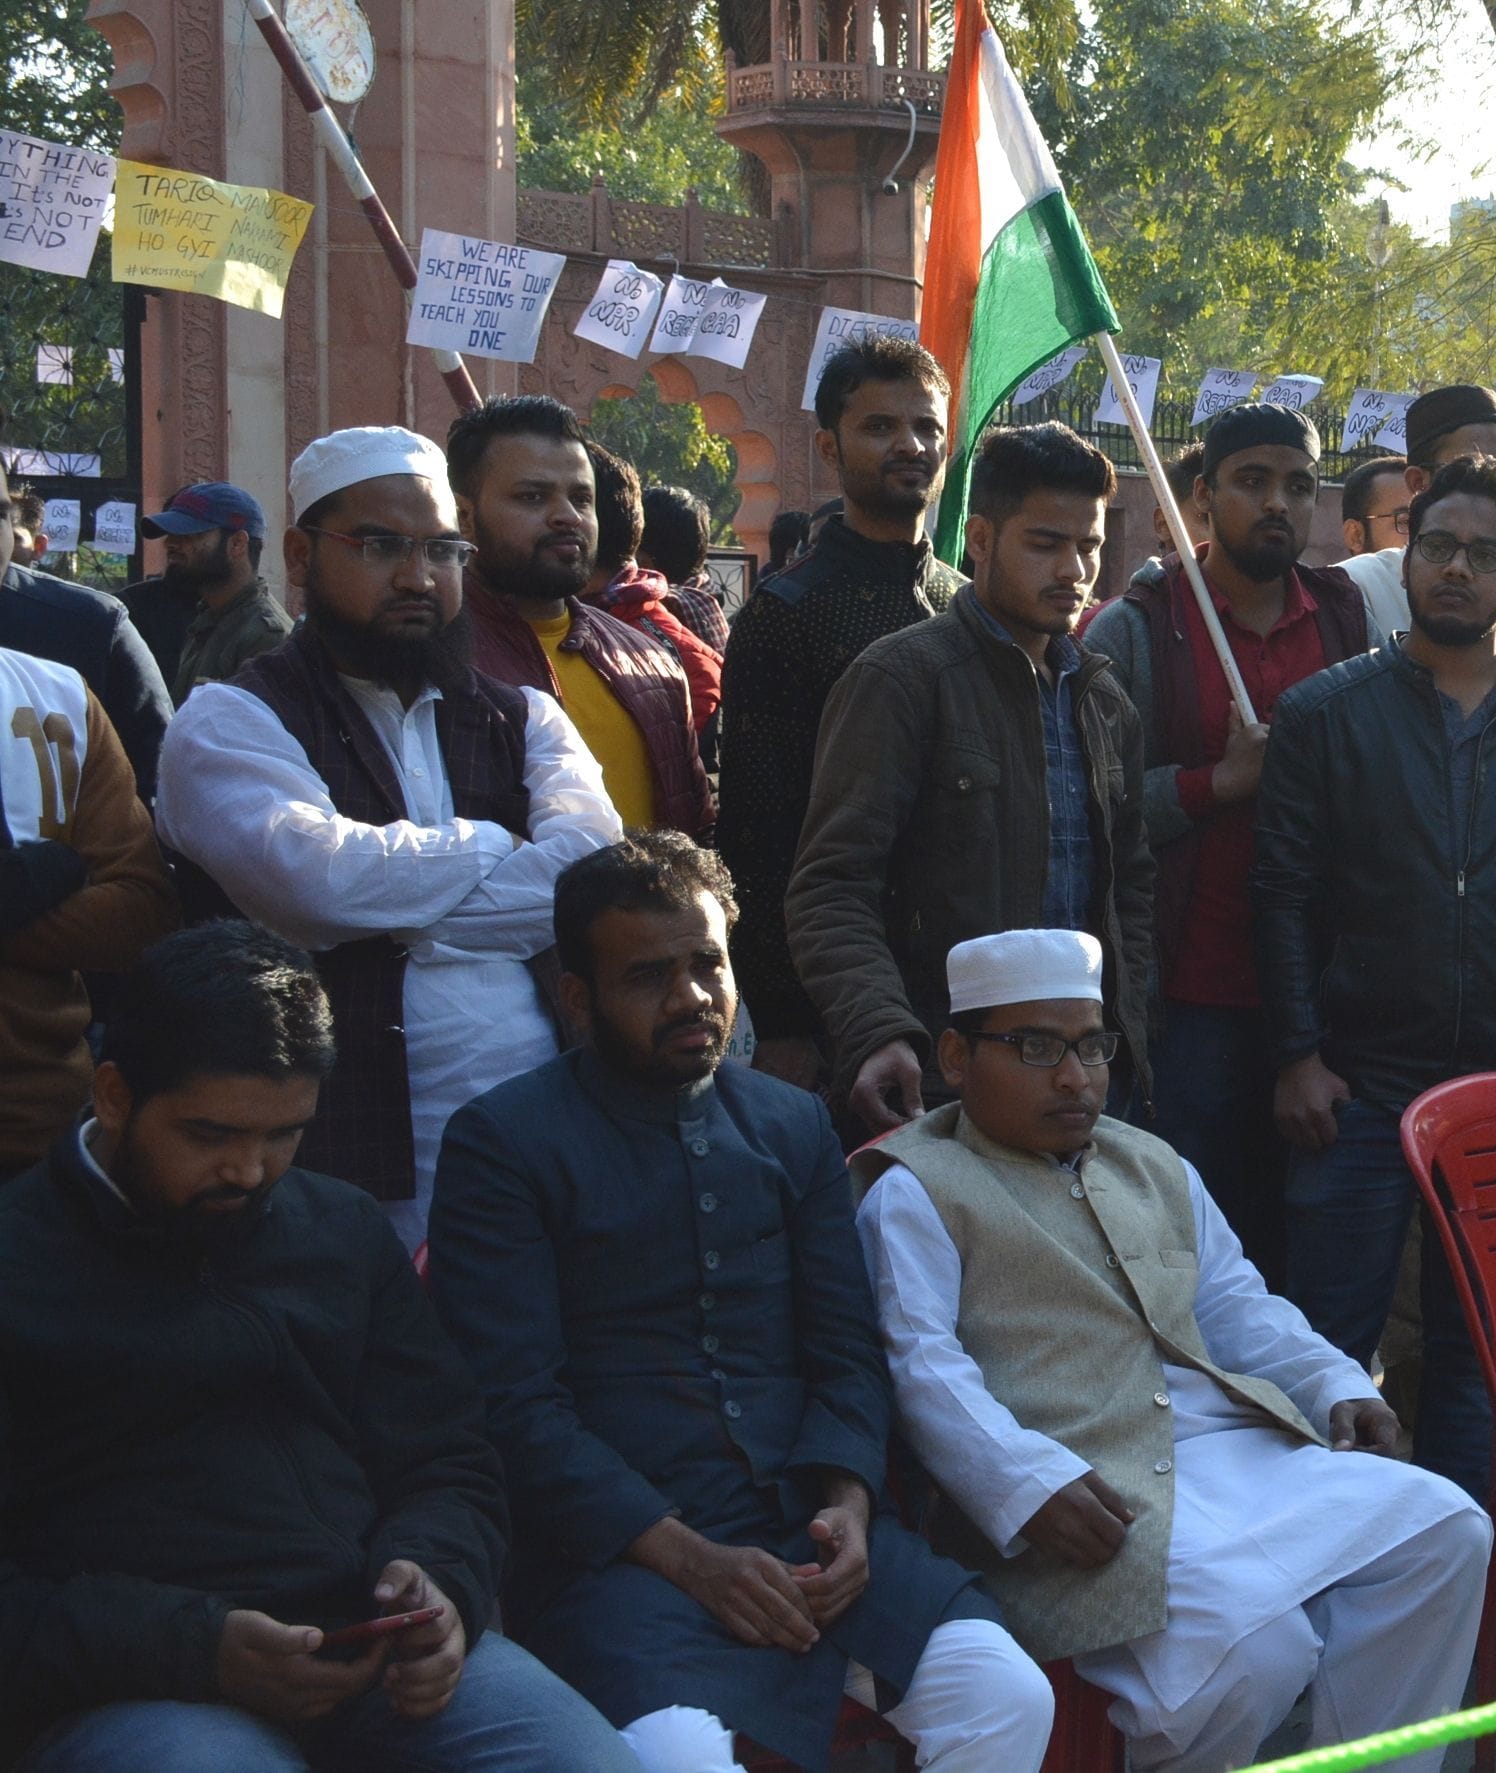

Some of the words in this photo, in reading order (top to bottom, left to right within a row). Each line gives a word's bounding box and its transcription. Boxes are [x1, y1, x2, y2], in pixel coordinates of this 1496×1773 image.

[0, 136, 109, 178] YTHING
[0, 161, 31, 180] IN
[38, 168, 85, 189] THE
[64, 191, 105, 209] NOT
[136, 174, 223, 206] TARIQ
[32, 206, 95, 231] NOT
[132, 202, 220, 232] TUMHARI
[4, 222, 67, 249] END
[138, 231, 164, 251] HO
[176, 237, 217, 263] GYI
[462, 239, 493, 262] WE
[494, 245, 530, 270] ARE
[425, 258, 512, 289] SKIPPING
[522, 273, 552, 295] OUR
[450, 285, 514, 309] LESSONS
[520, 296, 536, 312] TO
[420, 303, 466, 325] TEACH
[472, 309, 500, 329] YOU
[467, 330, 507, 351] ONE
